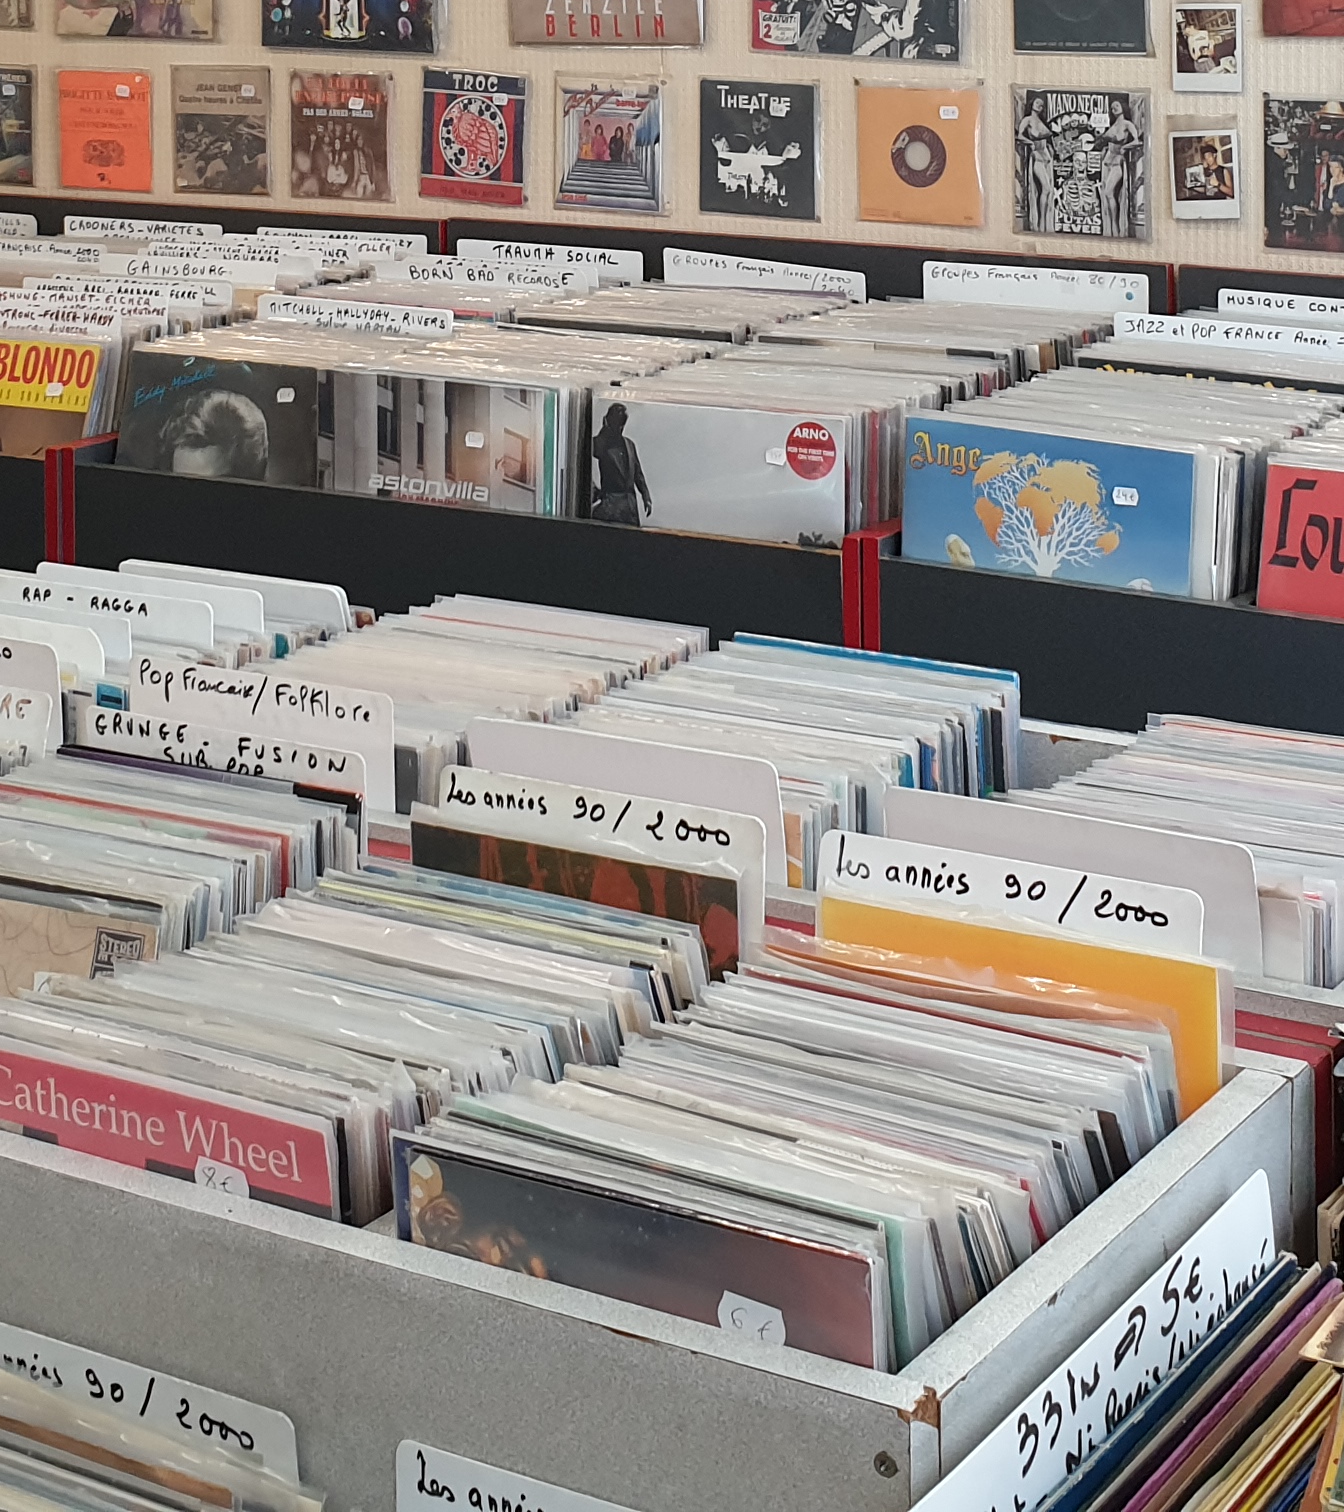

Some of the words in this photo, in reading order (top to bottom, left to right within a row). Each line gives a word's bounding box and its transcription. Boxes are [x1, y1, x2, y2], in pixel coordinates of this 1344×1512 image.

[545, 14, 666, 38] BERLIN
[452, 73, 499, 93] TROC
[1055, 210, 1102, 227] PUTAS
[566, 248, 619, 266] SOCIAL
[408, 263, 454, 283] BORN
[465, 267, 496, 283] BAD
[1225, 293, 1294, 313] MUSIQUE
[1123, 317, 1167, 338] JAZZ
[1172, 324, 1187, 337] et
[1190, 324, 1218, 341] POP
[1222, 326, 1283, 345] FRANCE
[792, 426, 830, 442] ARNO
[909, 430, 983, 476] Ange
[367, 473, 490, 504] astonvilla
[22, 585, 53, 606] RAP
[89, 595, 149, 619] RAGGA
[94, 712, 189, 744] GRUNGE
[237, 736, 348, 774] FUSION
[97, 930, 143, 959] STEREO
[174, 1108, 303, 1184] Wheel
